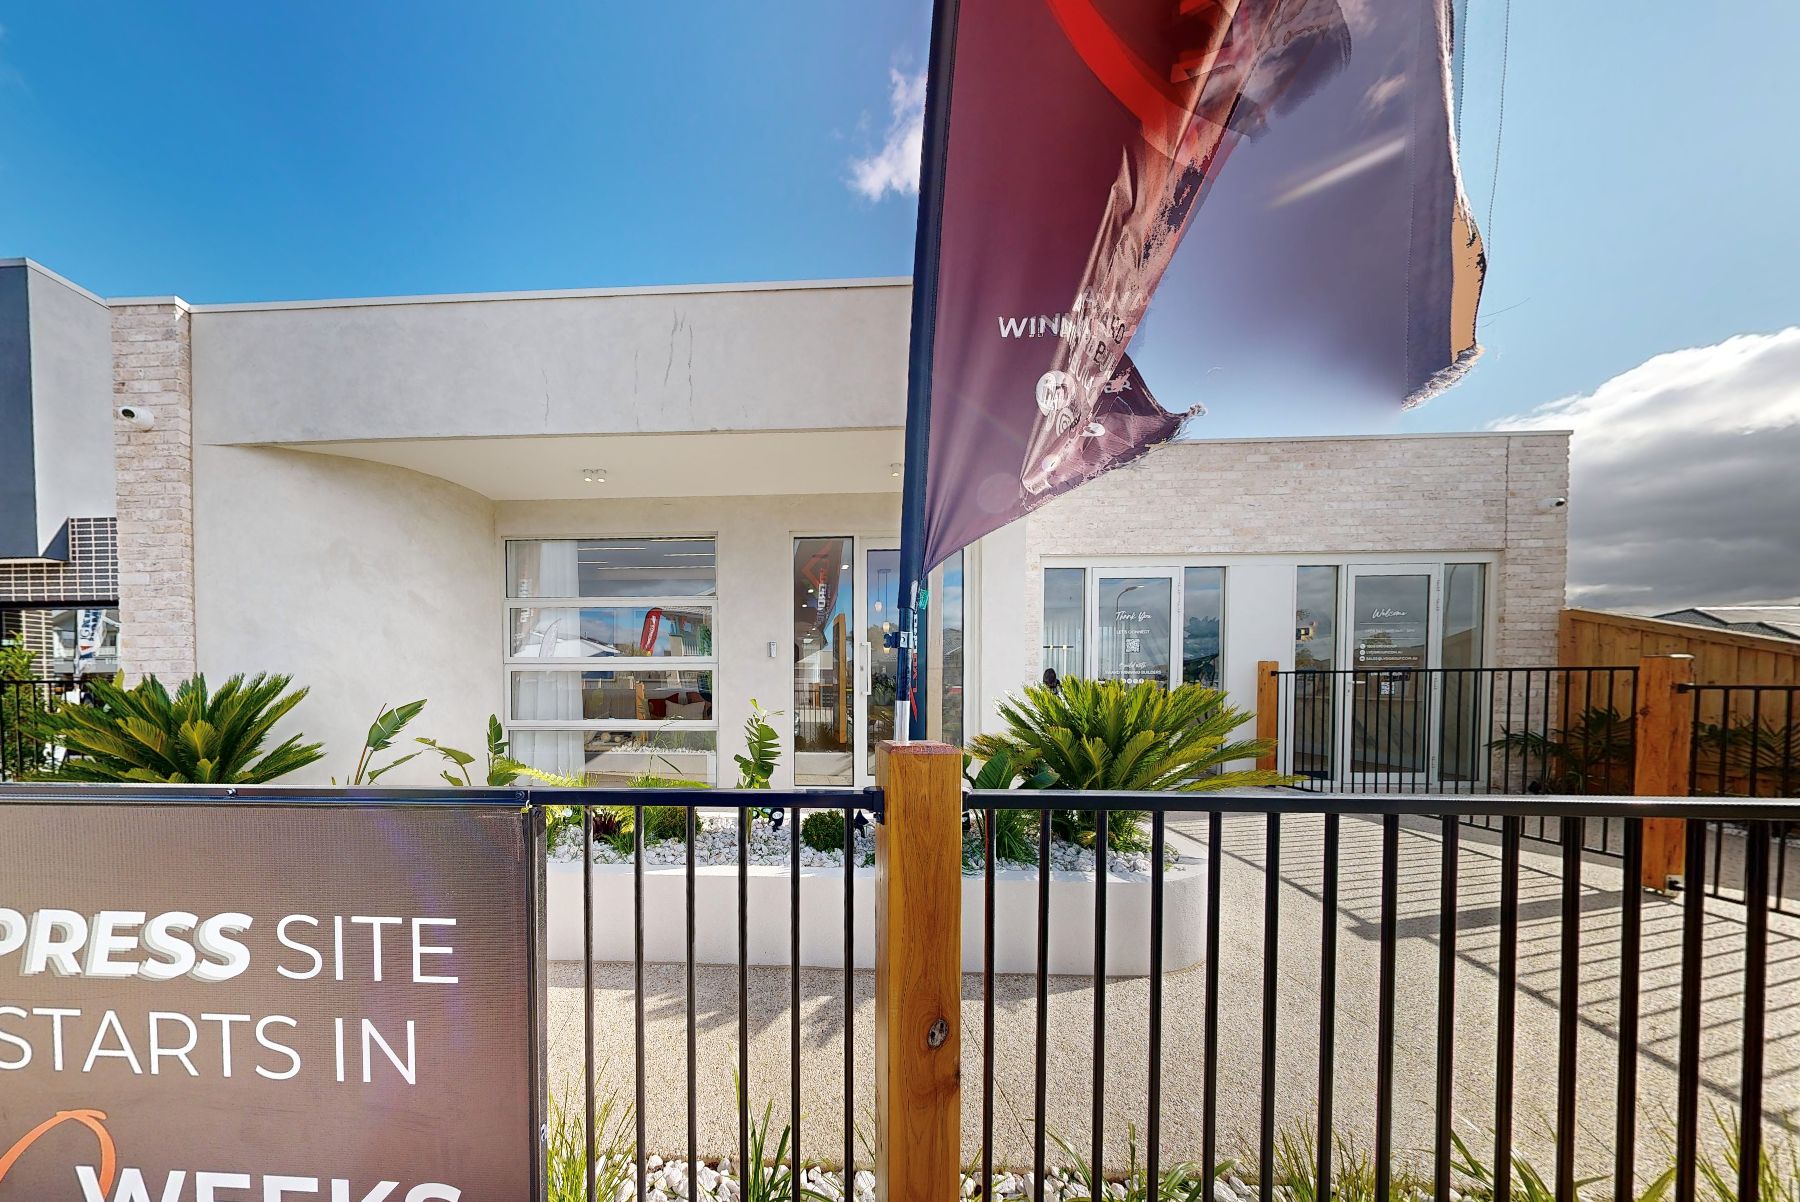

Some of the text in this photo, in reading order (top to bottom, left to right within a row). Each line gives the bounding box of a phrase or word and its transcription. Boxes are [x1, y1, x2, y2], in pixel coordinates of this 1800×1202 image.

[1115, 610, 1152, 622] Thank You
[1372, 608, 1408, 619] Welcome
[276, 913, 459, 984] SITE
[0, 1006, 416, 1085] STARTS IN
